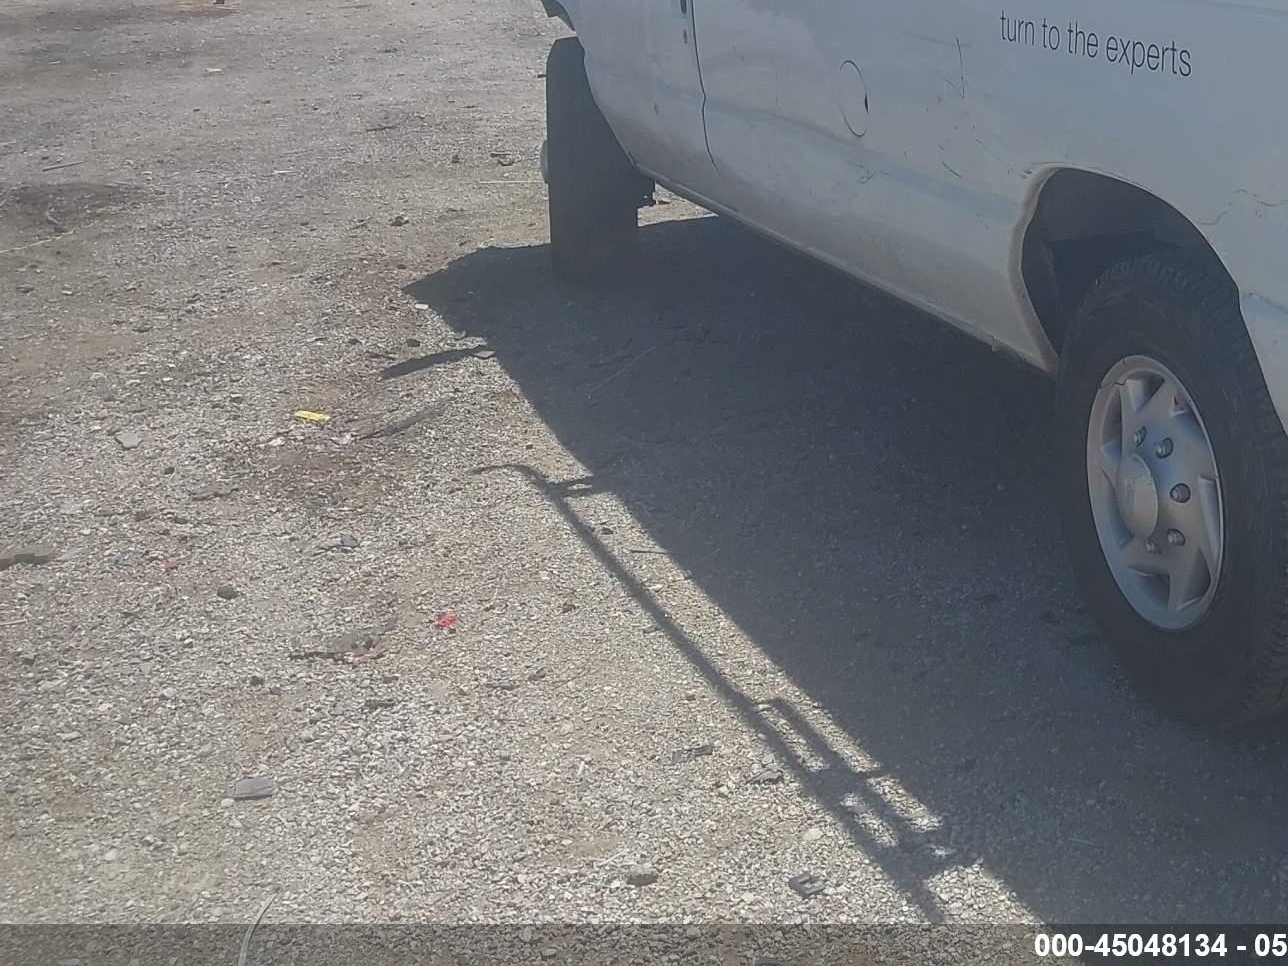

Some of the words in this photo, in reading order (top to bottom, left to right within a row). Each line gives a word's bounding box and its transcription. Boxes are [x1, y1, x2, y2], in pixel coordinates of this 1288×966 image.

[1000, 10, 1035, 46] turn
[1042, 17, 1060, 50] to
[1067, 21, 1099, 58] the
[1106, 35, 1192, 77] experts
